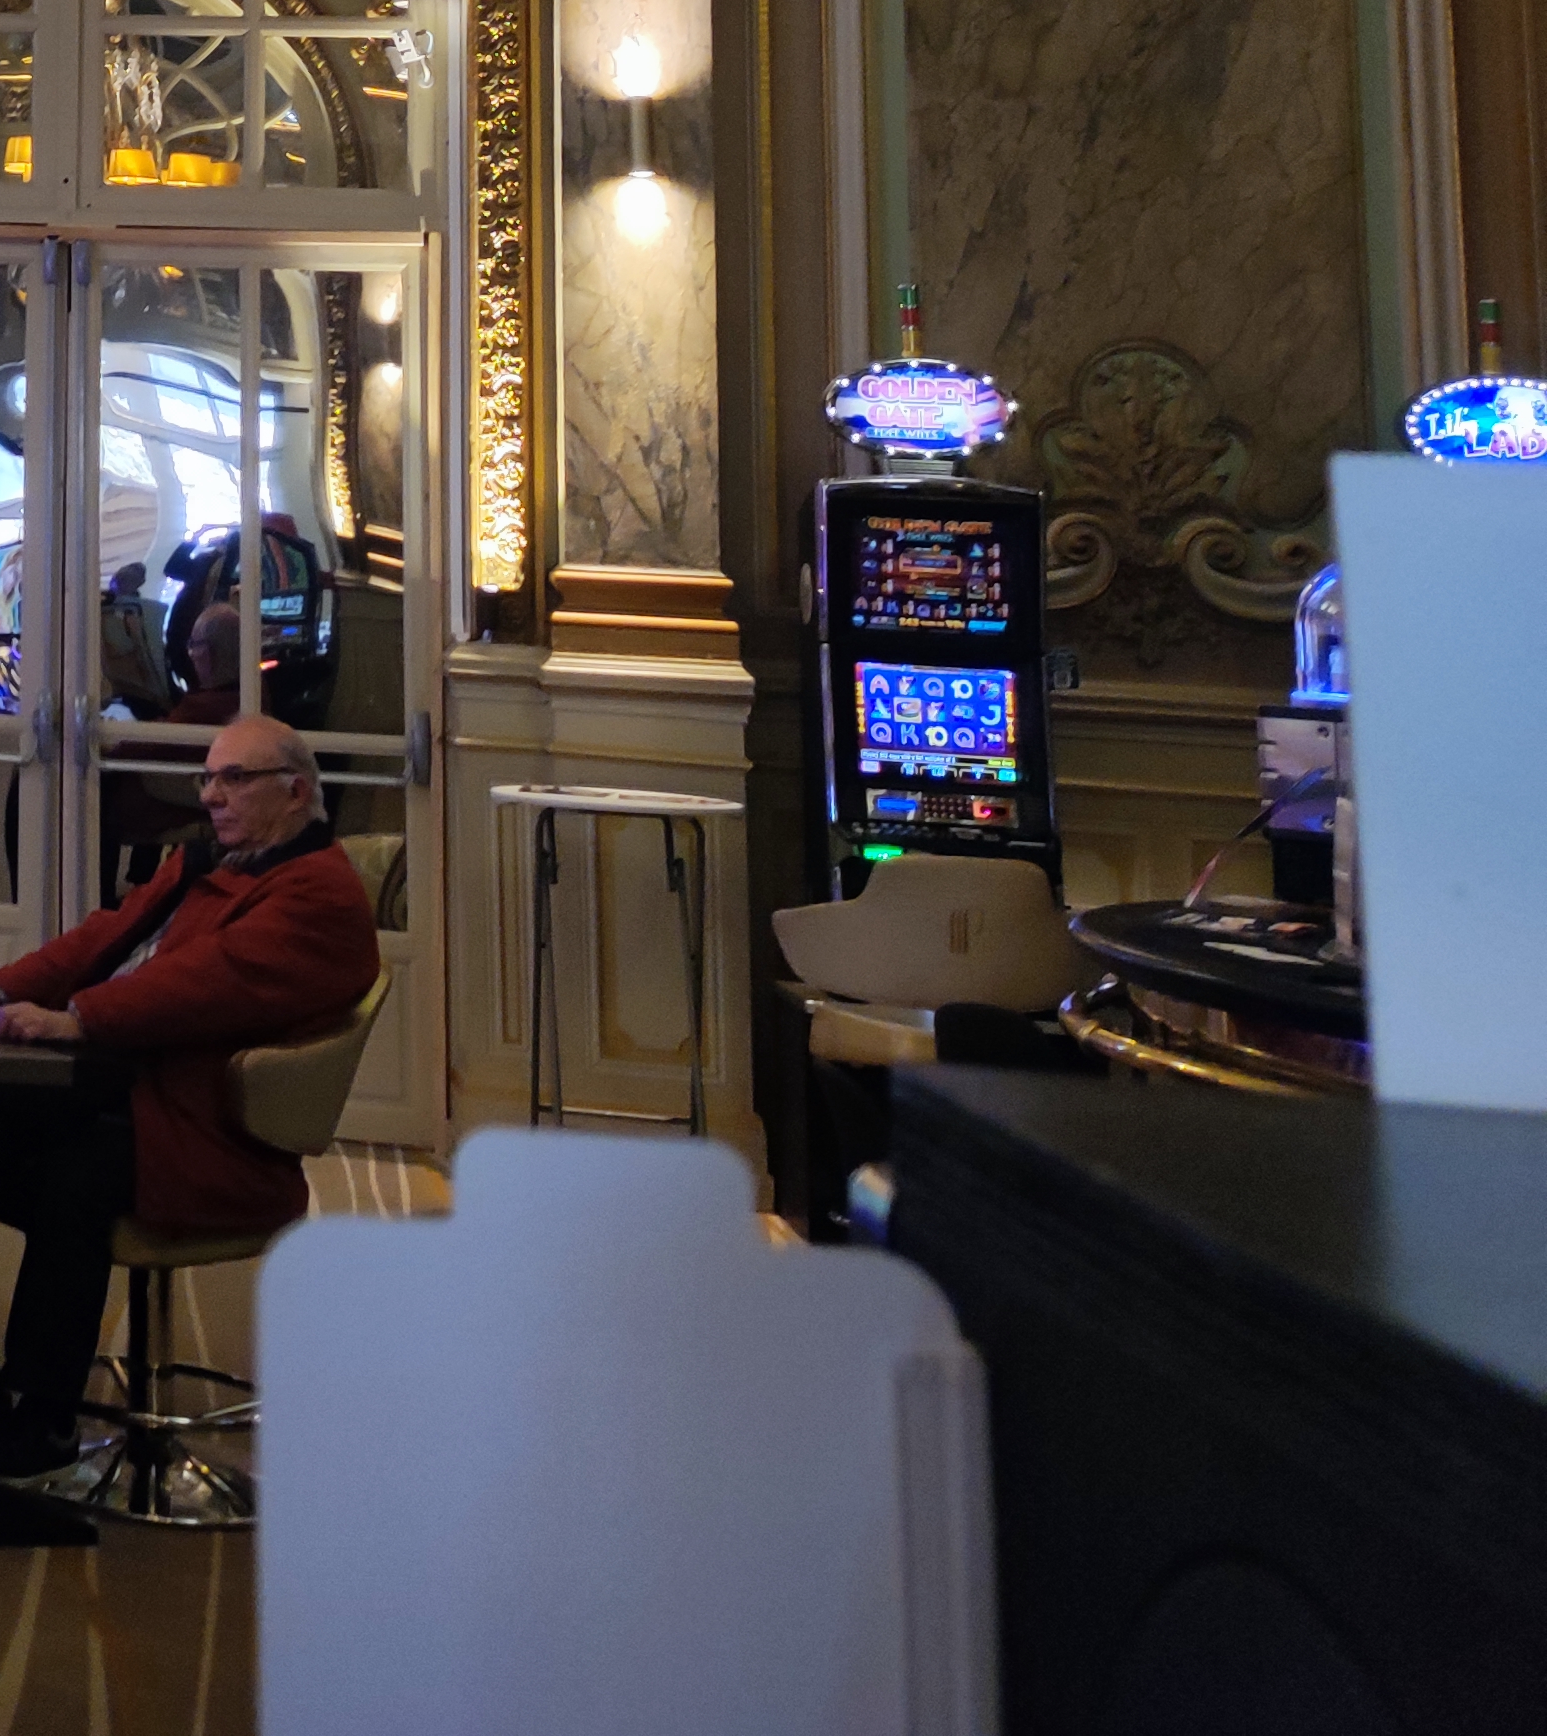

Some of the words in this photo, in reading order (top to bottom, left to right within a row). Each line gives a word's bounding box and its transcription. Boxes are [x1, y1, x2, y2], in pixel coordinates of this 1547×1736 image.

[857, 375, 977, 405] GOLDEN
[865, 403, 944, 429] GATE
[950, 678, 974, 700] 10
[980, 704, 1002, 726] J
[900, 723, 920, 746] K
[924, 725, 949, 747] 10
